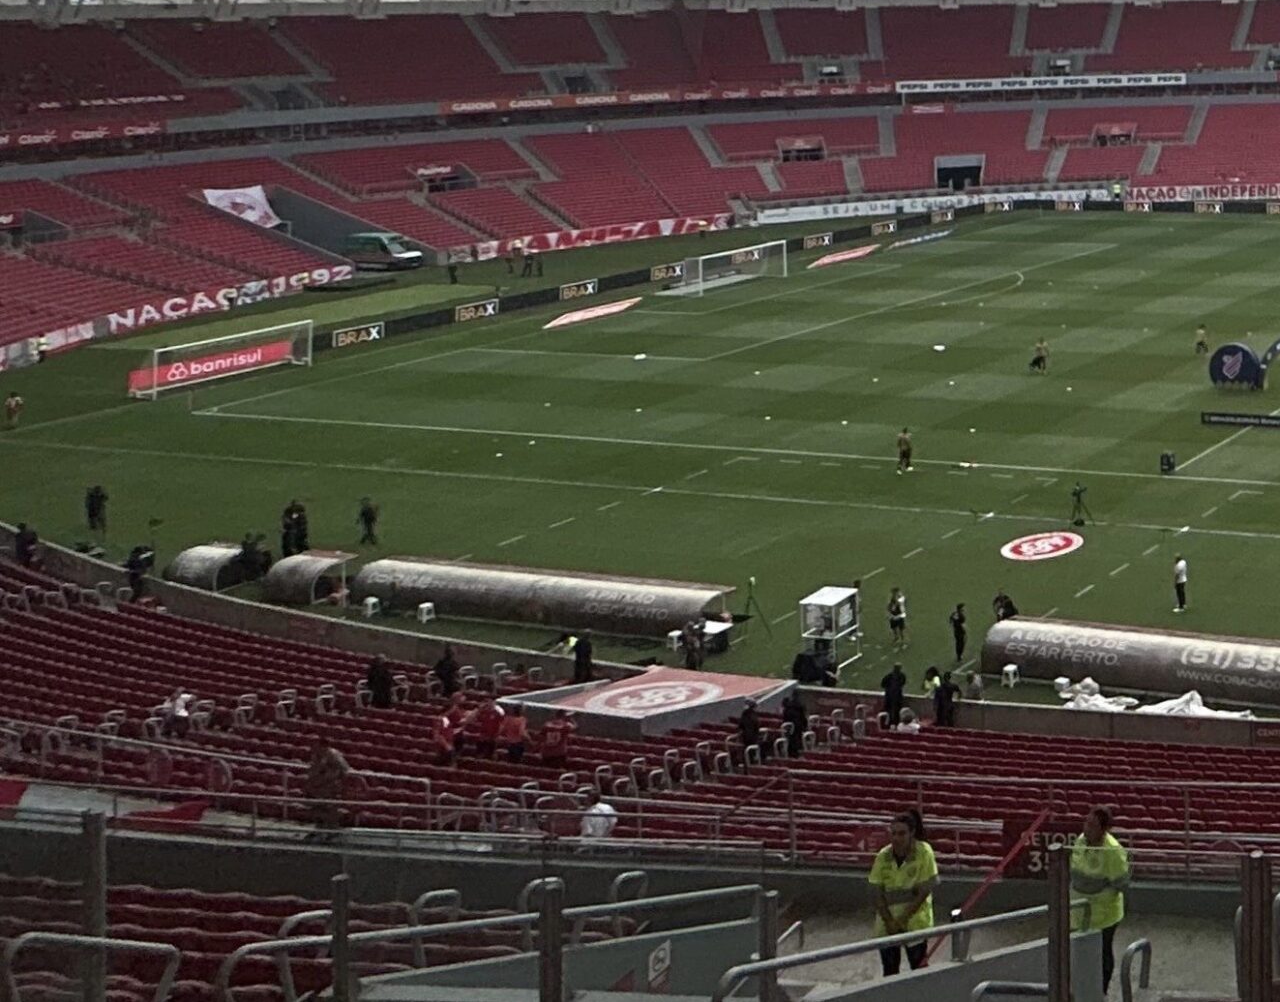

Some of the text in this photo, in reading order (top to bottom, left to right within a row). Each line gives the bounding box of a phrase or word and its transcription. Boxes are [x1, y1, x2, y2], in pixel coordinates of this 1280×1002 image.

[1157, 75, 1182, 83] PEPSI
[71, 129, 105, 140] Claro
[124, 124, 157, 136] Claro
[18, 133, 52, 145] Claro
[822, 205, 860, 216] SEJA
[869, 202, 890, 212] UM
[652, 265, 683, 281] BRAX
[561, 282, 595, 299] BRAX
[459, 302, 495, 321] BRAX
[337, 326, 381, 347] BRAX
[190, 349, 262, 376] banrisul
[1010, 630, 1023, 640] A
[1103, 638, 1128, 651] DE
[1004, 641, 1060, 660] ESTAR
[1181, 646, 1233, 669] (51)
[1021, 832, 1079, 847] SETOR
